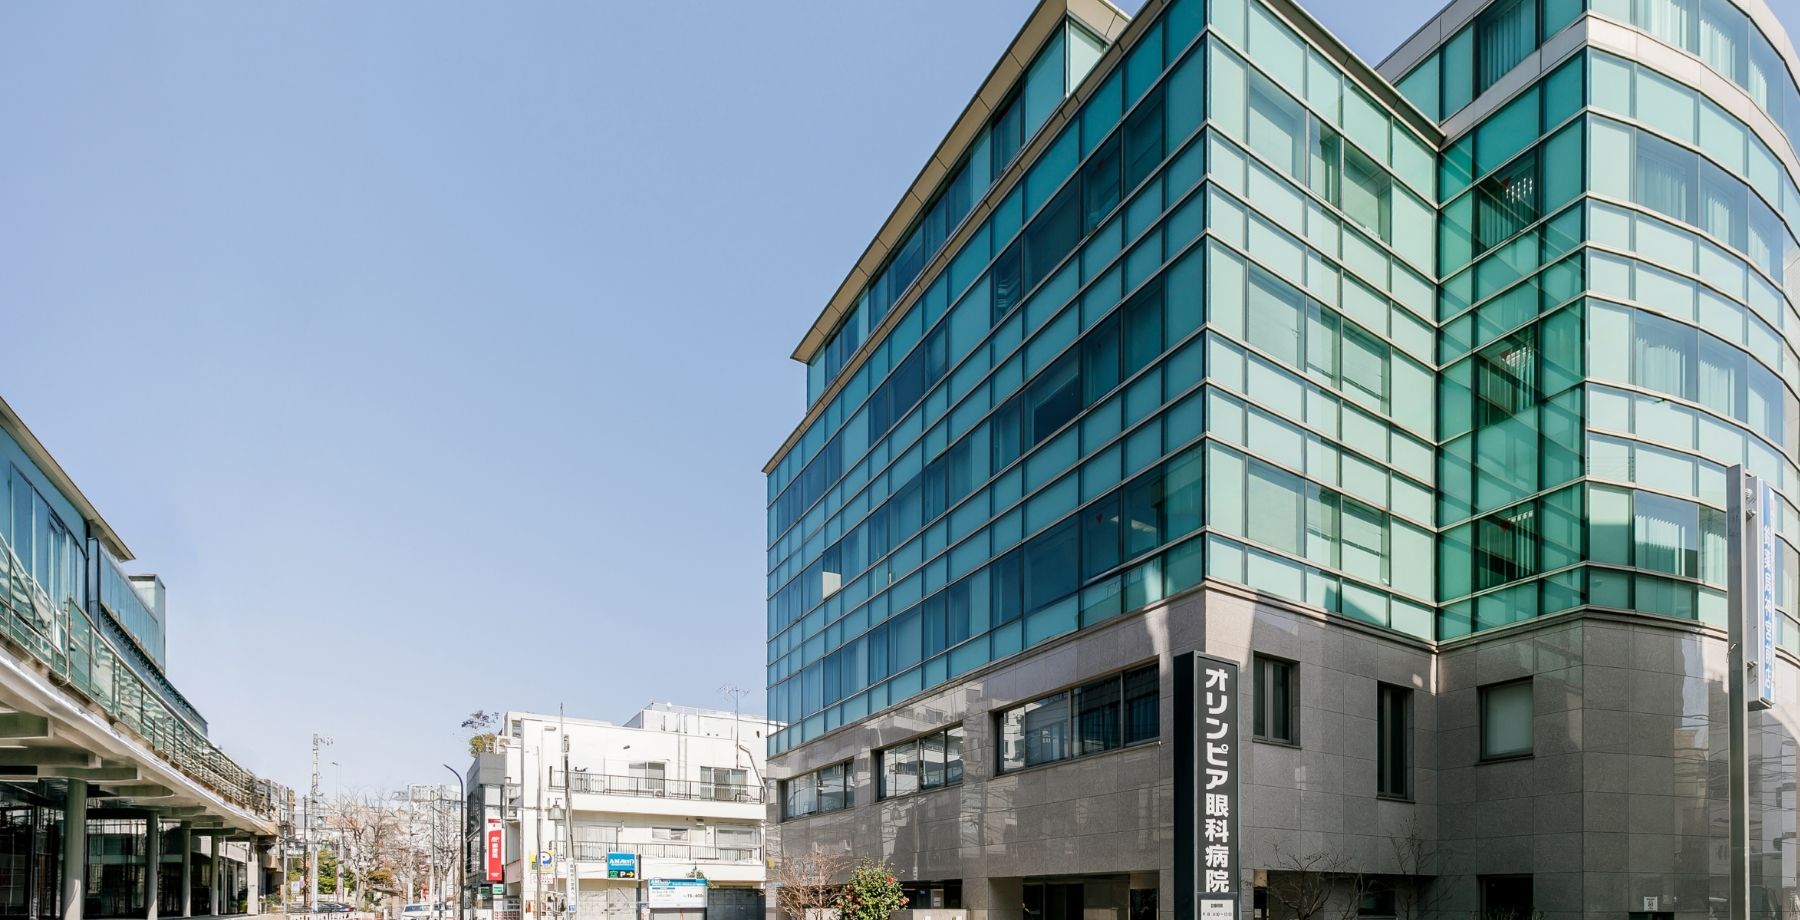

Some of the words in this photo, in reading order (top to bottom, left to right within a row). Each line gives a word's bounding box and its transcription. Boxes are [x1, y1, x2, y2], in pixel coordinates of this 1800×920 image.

[1205, 668, 1229, 893] オリンピア眼科病院
